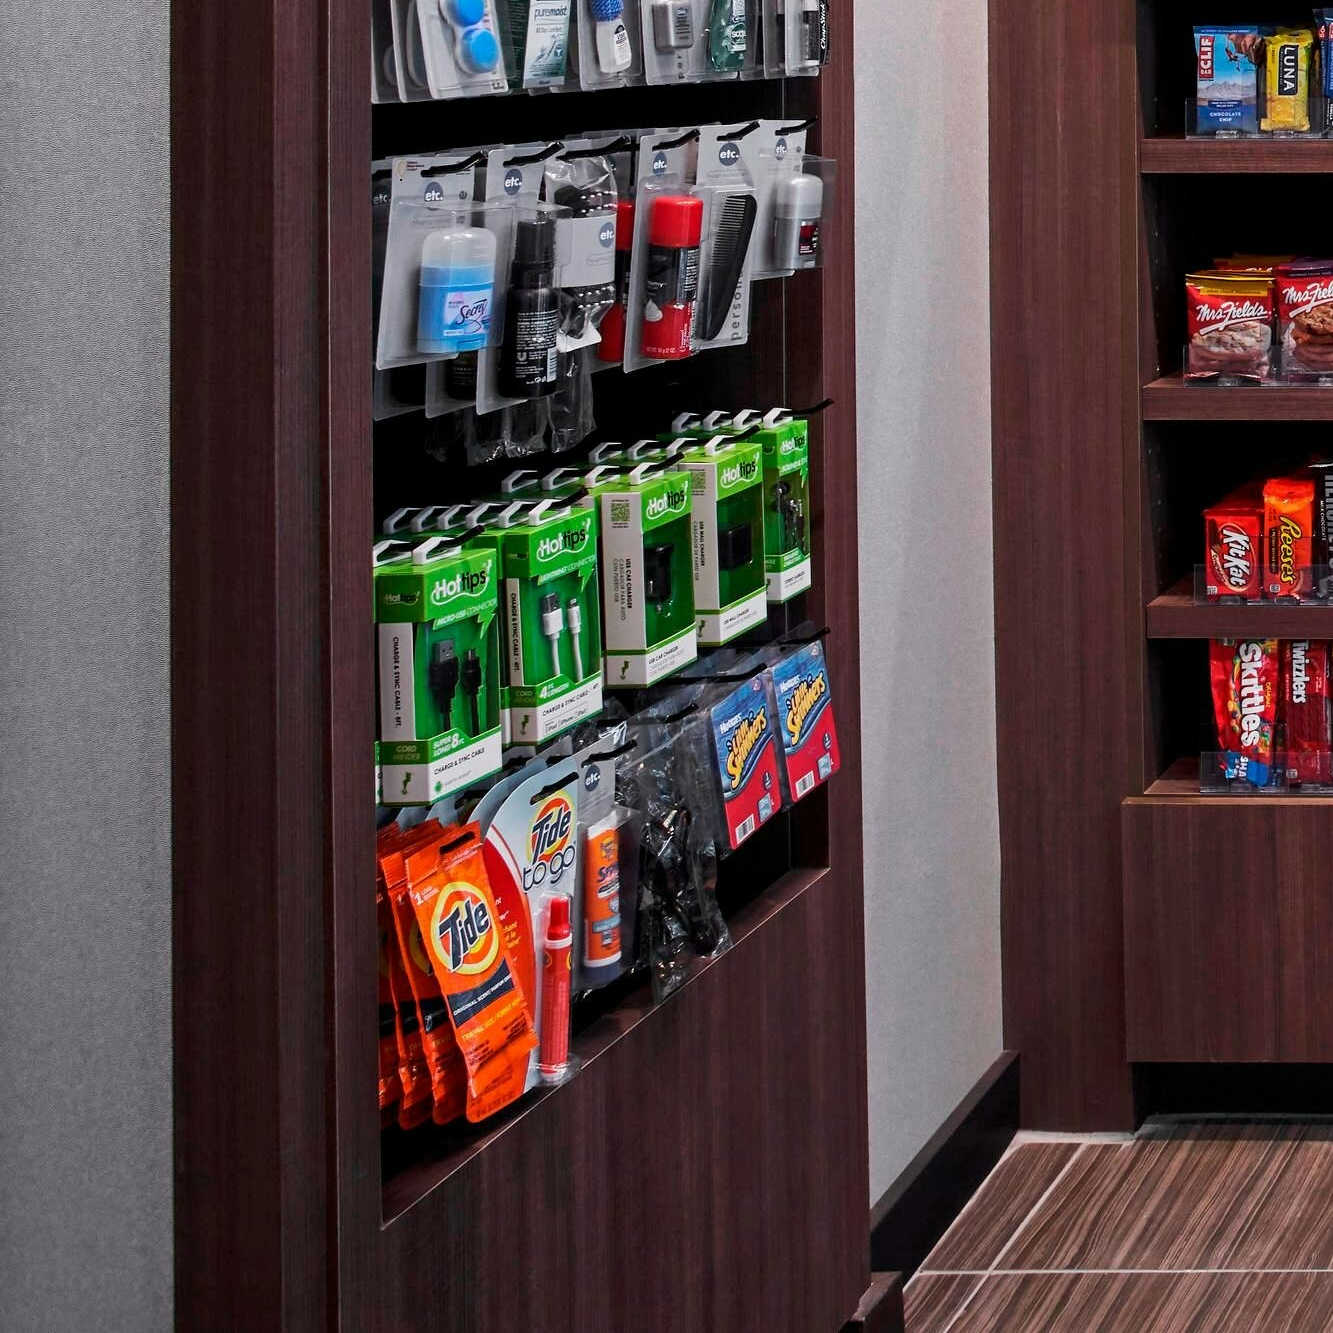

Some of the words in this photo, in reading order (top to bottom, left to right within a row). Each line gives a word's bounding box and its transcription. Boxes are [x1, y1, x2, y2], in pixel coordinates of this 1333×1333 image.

[1200, 36, 1213, 70] CLIF
[1283, 46, 1296, 92] LUNA
[720, 150, 739, 159] etc.
[372, 193, 391, 203] etc.
[424, 191, 444, 201] etc.
[504, 178, 522, 187] etc.
[600, 230, 615, 240] etc.
[455, 298, 488, 326] Secret
[1217, 301, 1268, 330] Fields
[721, 454, 759, 487] Hottips
[647, 483, 687, 518] Hottips
[536, 523, 589, 560] Hottips
[432, 563, 490, 604] Hottips
[1292, 641, 1308, 704] Twizzlers
[1239, 642, 1265, 747] Skittles
[585, 772, 601, 786] etc.
[531, 804, 573, 865] Tide
[522, 863, 546, 895] to
[550, 843, 576, 885] go
[438, 896, 492, 973] Tide
